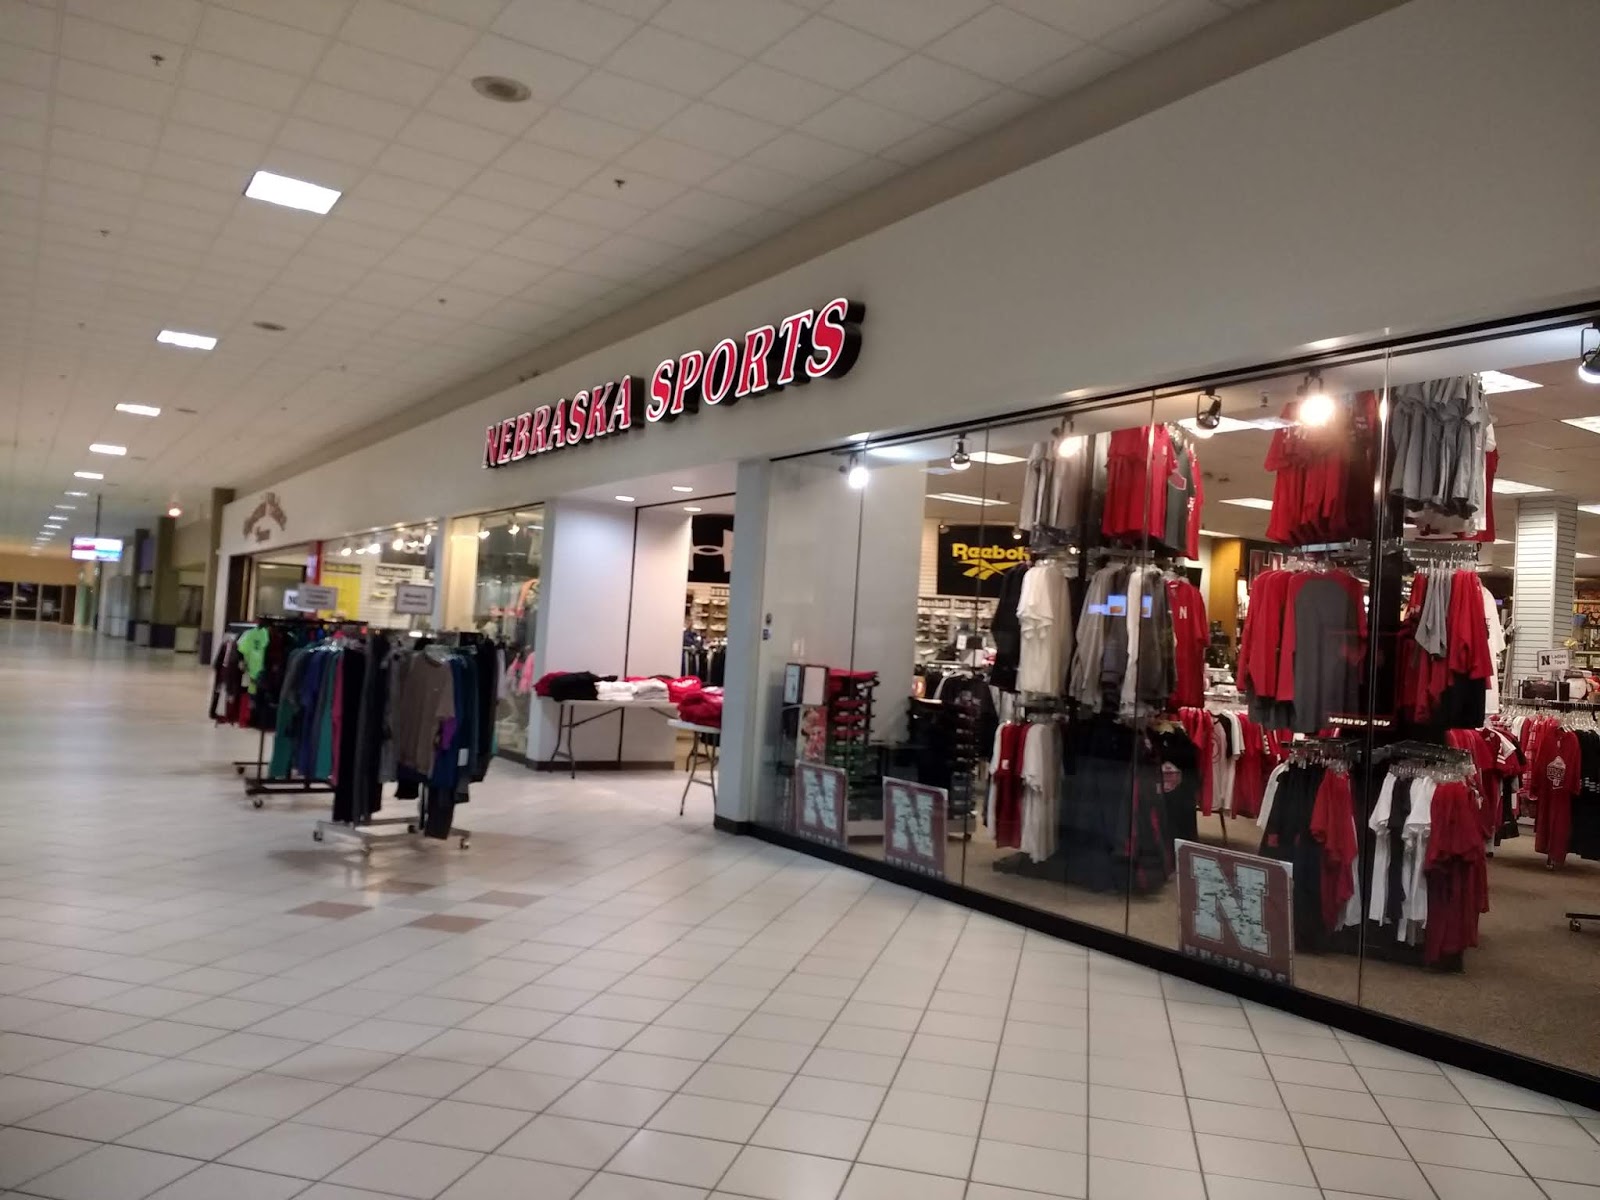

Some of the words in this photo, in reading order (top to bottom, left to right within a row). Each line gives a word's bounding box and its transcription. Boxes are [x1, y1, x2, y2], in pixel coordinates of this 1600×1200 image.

[481, 374, 632, 470] NEBRASKA
[646, 297, 849, 424] SPORTS
[951, 543, 1031, 561] Reebok
[1179, 605, 1188, 619] N
[1541, 655, 1551, 666] N
[803, 768, 838, 831] N
[891, 786, 935, 858] N
[1190, 853, 1271, 959] N
